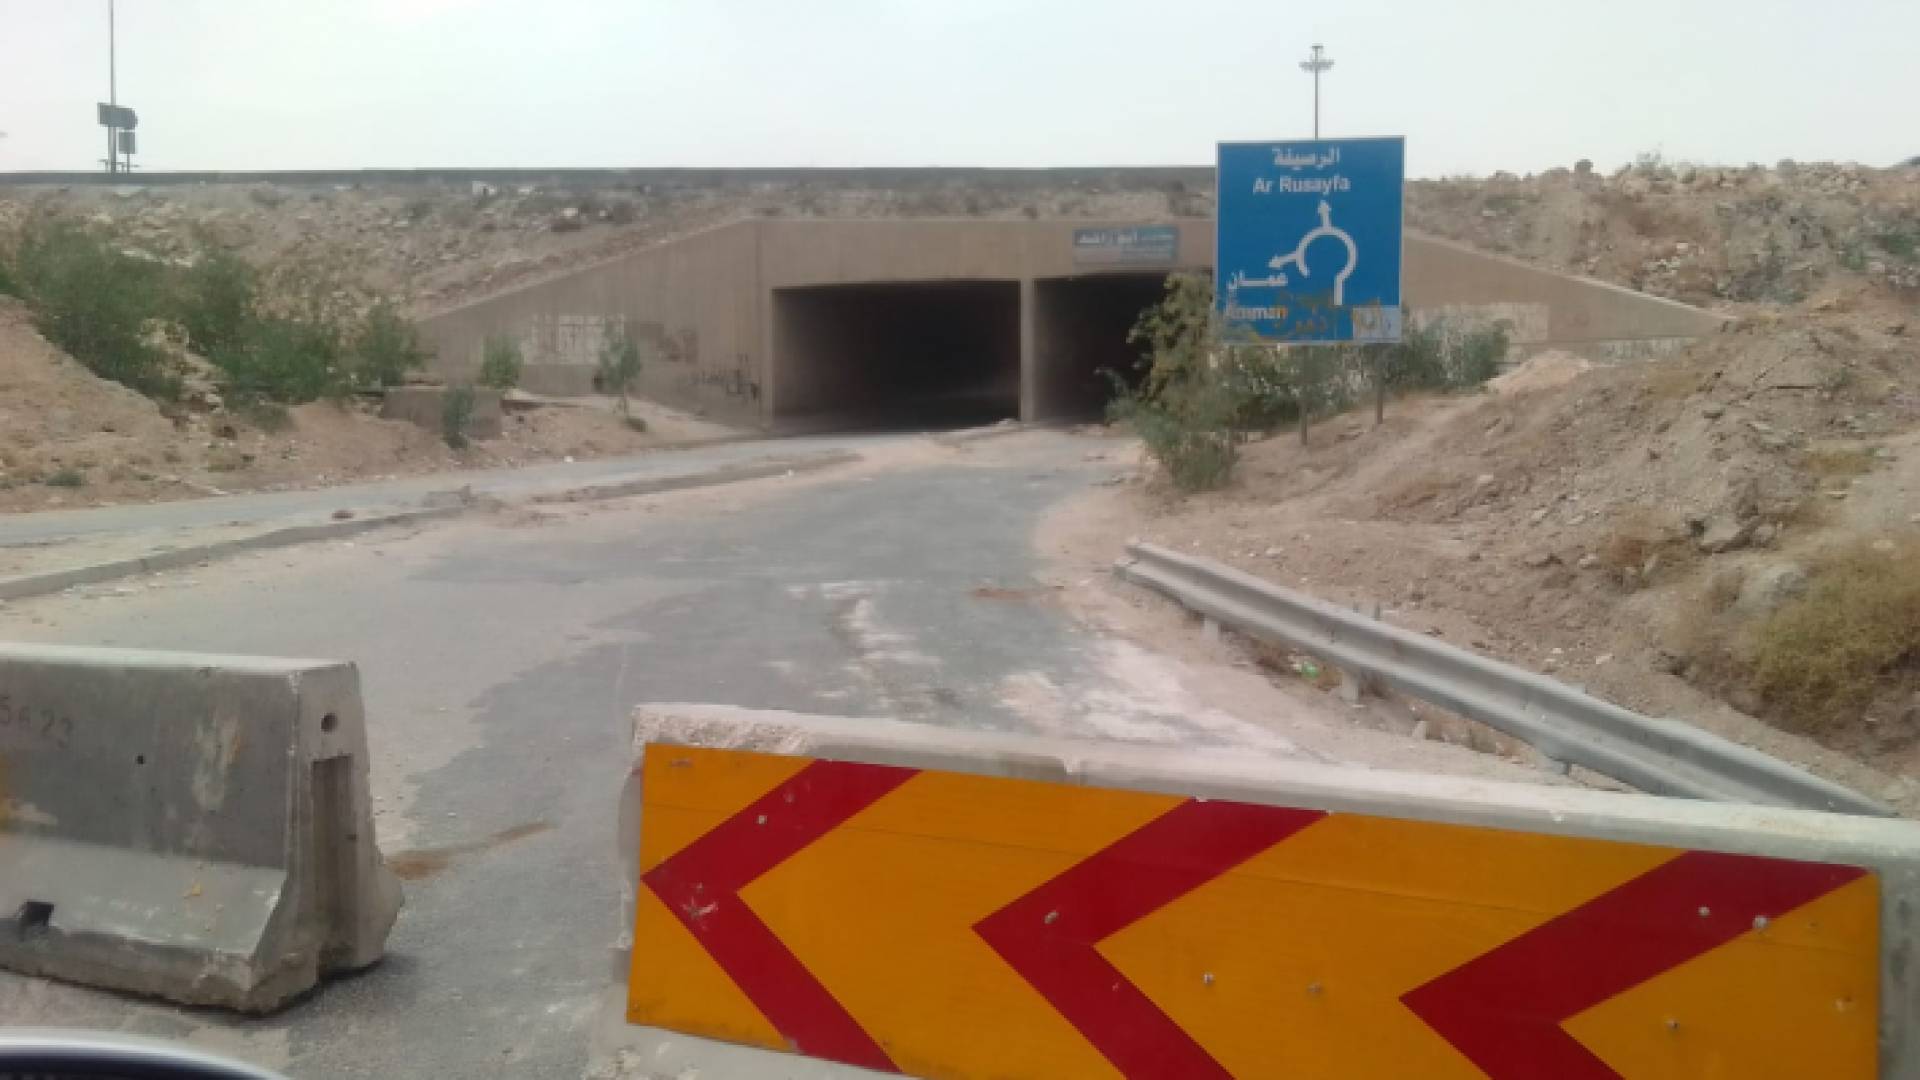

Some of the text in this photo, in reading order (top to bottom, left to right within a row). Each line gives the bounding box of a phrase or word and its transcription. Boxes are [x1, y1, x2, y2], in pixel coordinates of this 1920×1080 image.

[1272, 146, 1341, 170] الرصيفة
[1253, 175, 1351, 195] Ar Rusayfa
[1228, 270, 1289, 290] عمان
